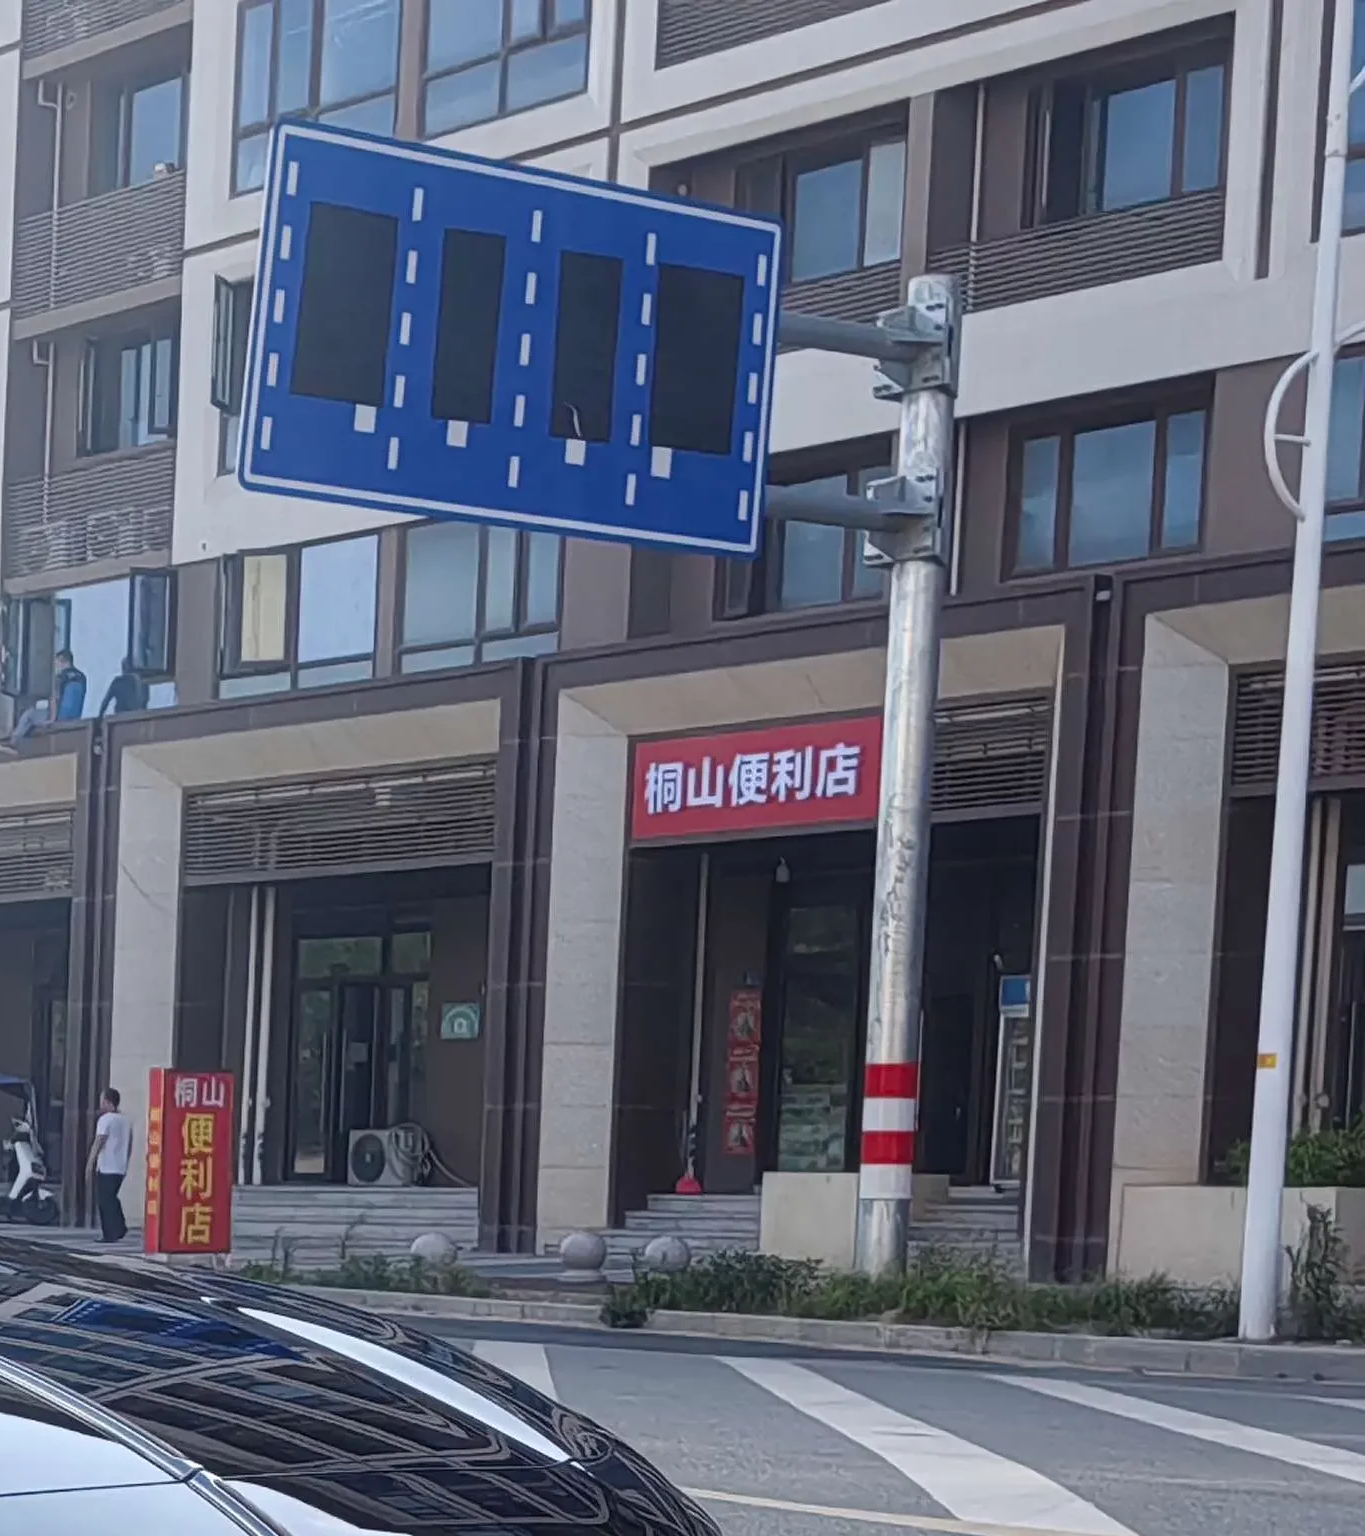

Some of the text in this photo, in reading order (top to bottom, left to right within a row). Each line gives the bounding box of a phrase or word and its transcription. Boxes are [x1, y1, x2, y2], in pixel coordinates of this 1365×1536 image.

[644, 743, 861, 815] 桐山便利店
[174, 1075, 225, 1109] 桐山
[179, 1112, 215, 1245] 便利店
